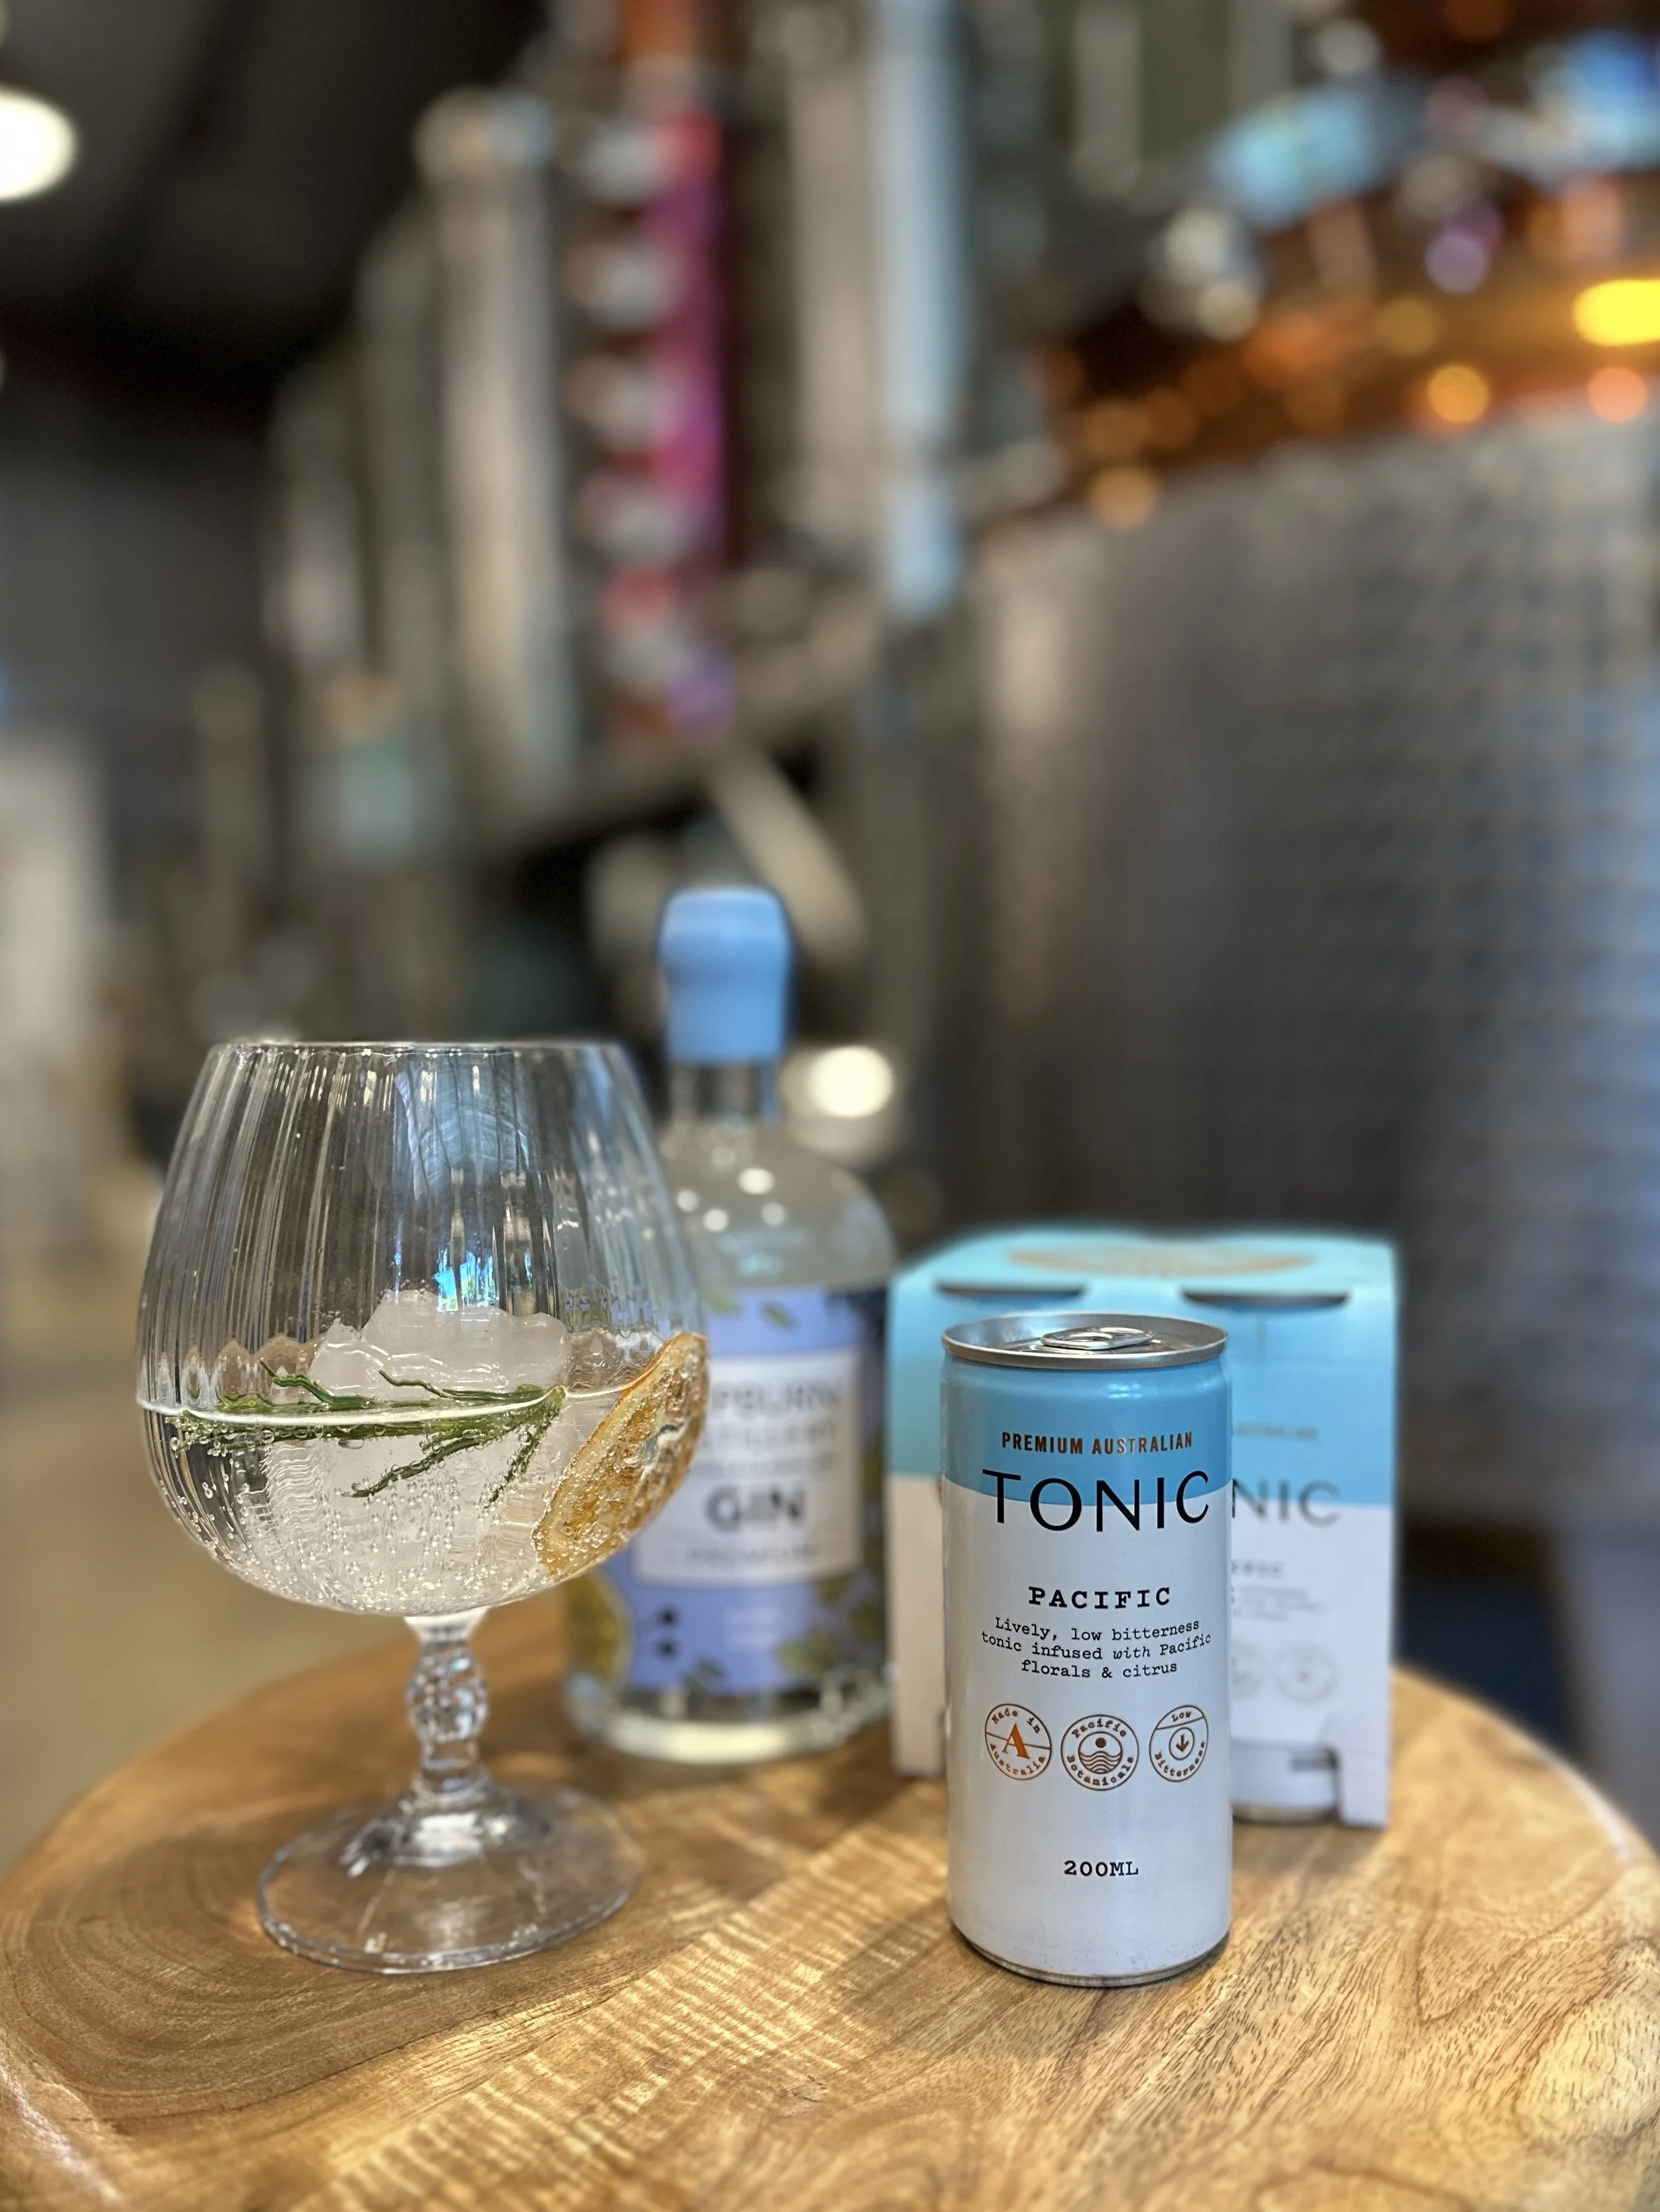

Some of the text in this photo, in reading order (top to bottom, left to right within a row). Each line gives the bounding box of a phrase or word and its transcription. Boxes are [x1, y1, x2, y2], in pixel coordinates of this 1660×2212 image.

[1001, 1431, 1193, 1454] PREMIUM AUSTRALIAN
[982, 1469, 1208, 1532] TONIC
[1232, 1478, 1341, 1527] NIC
[1029, 1586, 1171, 1609] PACIFIC
[995, 1616, 1199, 1642] Lively, low bitterness
[981, 1631, 1210, 1659] tonic infused with Pacific
[1021, 1659, 1177, 1678] florals & citrus
[991, 1708, 1018, 1725] Made
[1072, 1718, 1126, 1738] Pacific
[1171, 1711, 1191, 1723] Low
[990, 1743, 1046, 1776] Australia
[1067, 1754, 1133, 1786] Botanicals
[1155, 1741, 1204, 1777] Bitterness
[1064, 1860, 1139, 1877] 200ML
